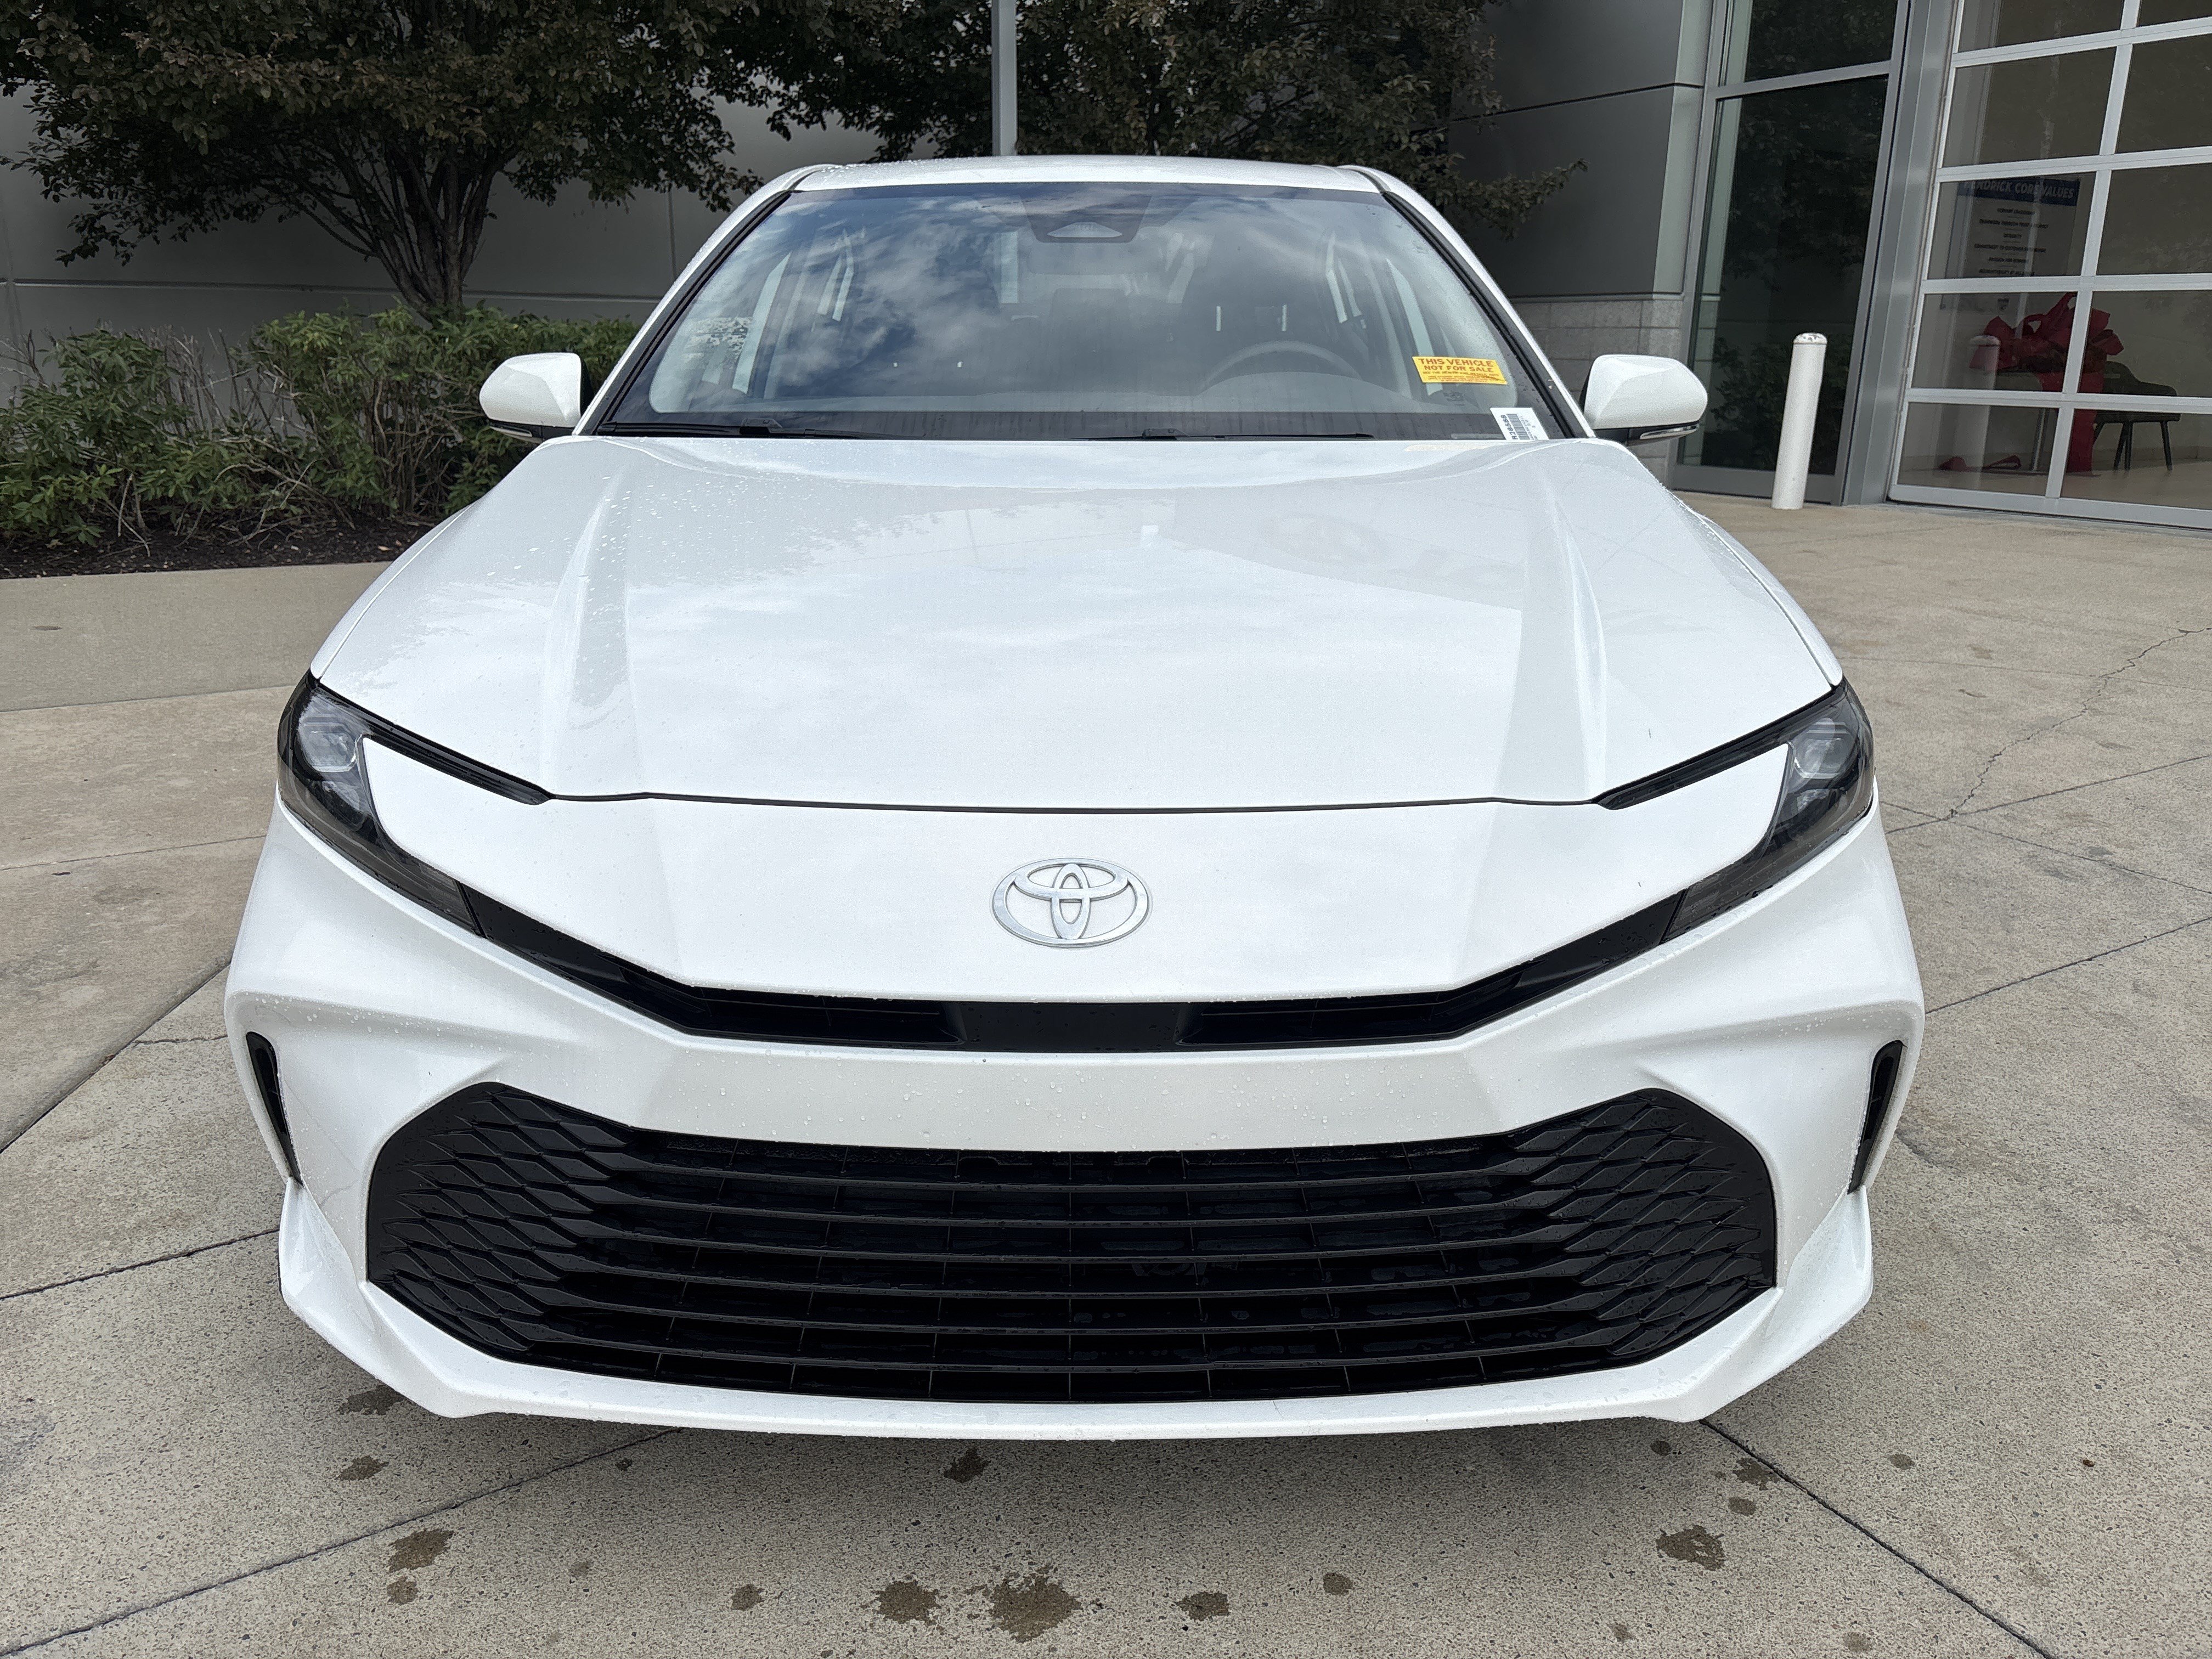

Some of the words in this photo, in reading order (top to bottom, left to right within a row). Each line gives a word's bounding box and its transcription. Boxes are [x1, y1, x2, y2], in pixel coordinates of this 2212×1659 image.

[2014, 182, 2040, 195] CORE
[2042, 185, 2074, 199] VALUES
[1446, 359, 1494, 367] VEHICLE
